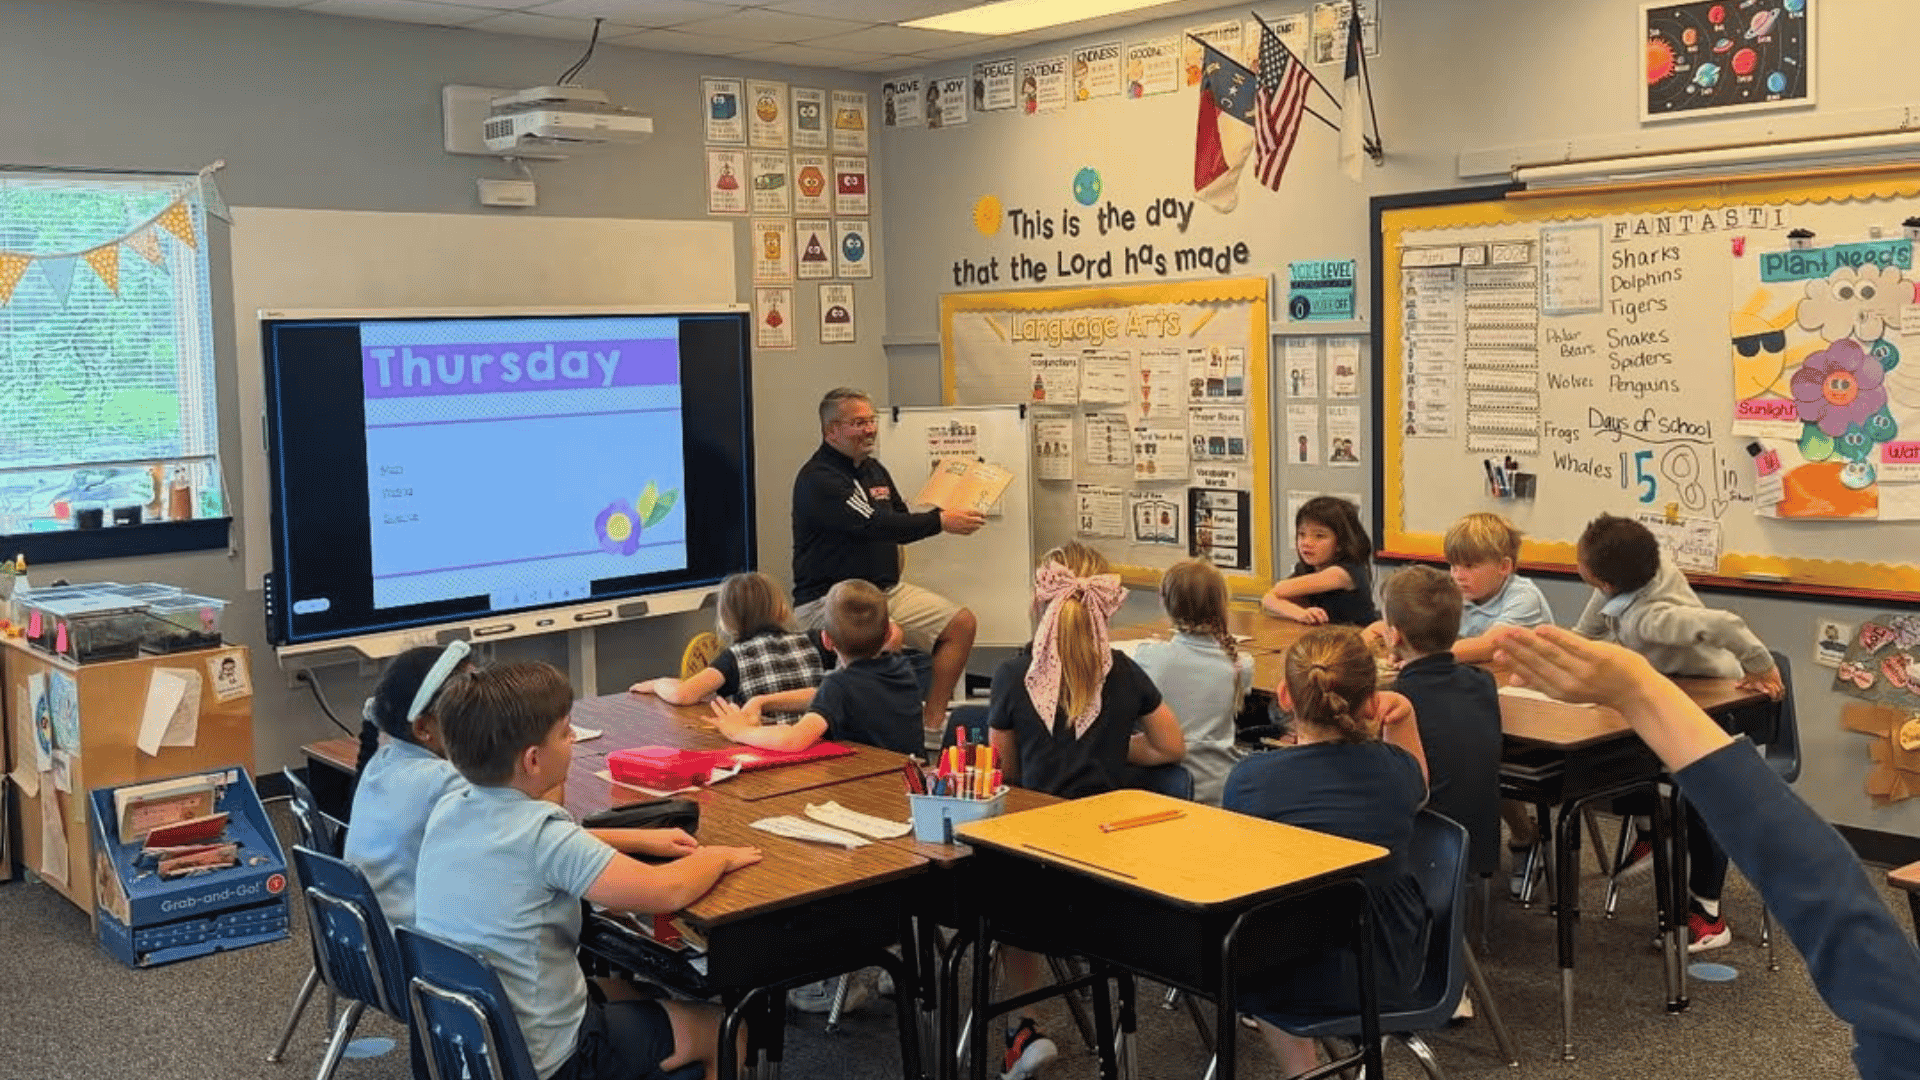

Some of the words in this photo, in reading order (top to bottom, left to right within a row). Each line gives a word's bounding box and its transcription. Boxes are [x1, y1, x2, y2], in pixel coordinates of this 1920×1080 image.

[1077, 47, 1120, 63] KINDNESS
[984, 63, 1014, 77] PEACE
[1023, 62, 1064, 77] PATIENCE
[895, 80, 920, 94] LOVE
[943, 80, 964, 93] JOY
[1008, 209, 1053, 239] This
[1062, 209, 1080, 237] is
[1097, 201, 1135, 235] the
[1146, 198, 1194, 233] day
[953, 257, 999, 286] that
[1011, 253, 1047, 282] the
[1057, 251, 1112, 280] Lord
[1125, 244, 1167, 276] has
[1175, 242, 1249, 274] made
[1611, 246, 1680, 270] Sharks
[1766, 251, 1828, 275] Plant
[1321, 262, 1351, 278] LEVEL
[1611, 267, 1683, 293] Dolphins
[1609, 298, 1668, 324] Tigers
[1011, 314, 1118, 347] Language
[1125, 309, 1182, 339] Arts
[1546, 328, 1582, 343] Polar
[1606, 328, 1670, 349] Snakes
[1560, 344, 1596, 357] Bears
[1608, 351, 1672, 371] Spiders
[370, 344, 621, 388] Thursday
[1032, 357, 1077, 369] conjunctions
[1547, 373, 1594, 389] Wolves
[1608, 373, 1680, 399] Penguins
[1738, 401, 1794, 419] Sunlight
[1544, 421, 1579, 444] Frogs
[1589, 407, 1629, 442] Days
[1634, 408, 1656, 432] of
[1553, 450, 1612, 479] Whales
[1720, 459, 1738, 490] in
[161, 882, 260, 912] Grab-and-Go!
